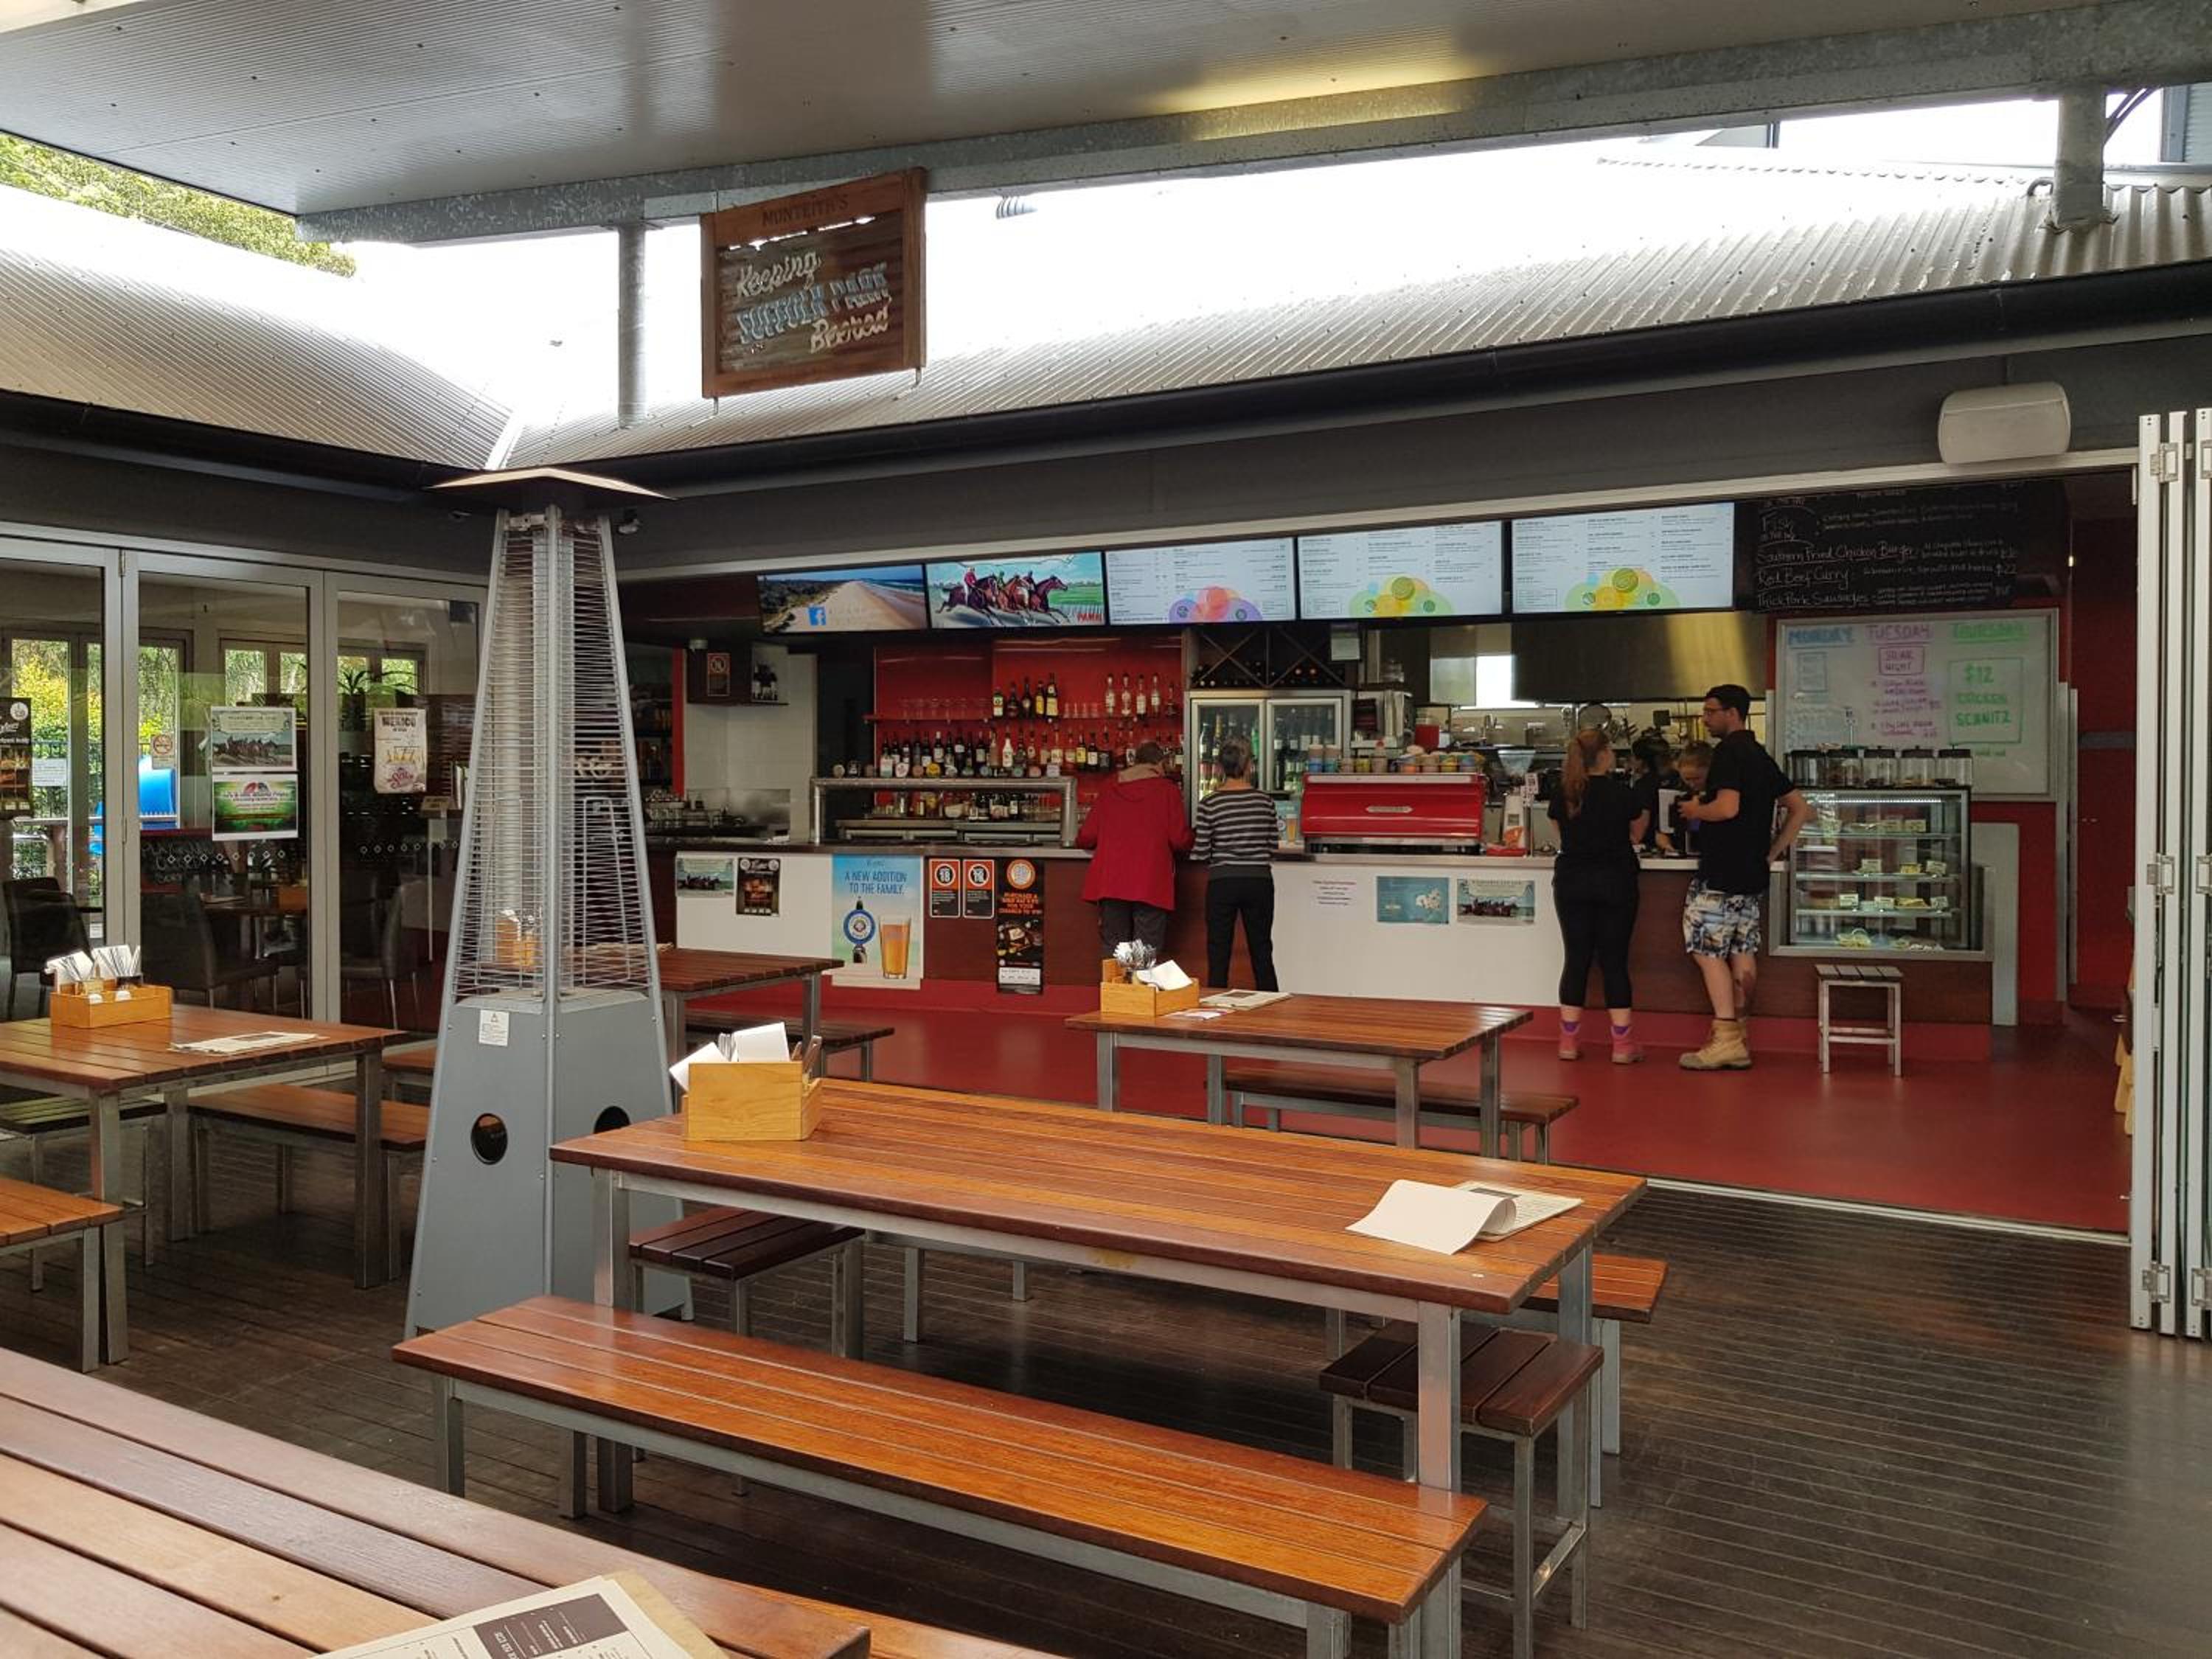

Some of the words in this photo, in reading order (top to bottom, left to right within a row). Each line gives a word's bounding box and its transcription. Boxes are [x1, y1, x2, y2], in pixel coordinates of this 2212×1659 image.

[737, 251, 821, 299] Keeping
[737, 283, 829, 344] SUFFOLK
[1834, 544, 1877, 559] Chicken
[1877, 540, 1913, 563] Burger
[1784, 567, 1810, 587] Beef
[1813, 566, 1848, 591] Curry
[1865, 625, 1930, 640] TUESDAY
[1964, 664, 1994, 684] $12
[844, 872, 850, 882] A
[852, 871, 872, 883] NEW
[872, 871, 908, 883] ADDITION
[849, 883, 859, 894] TO
[861, 883, 874, 894] THE
